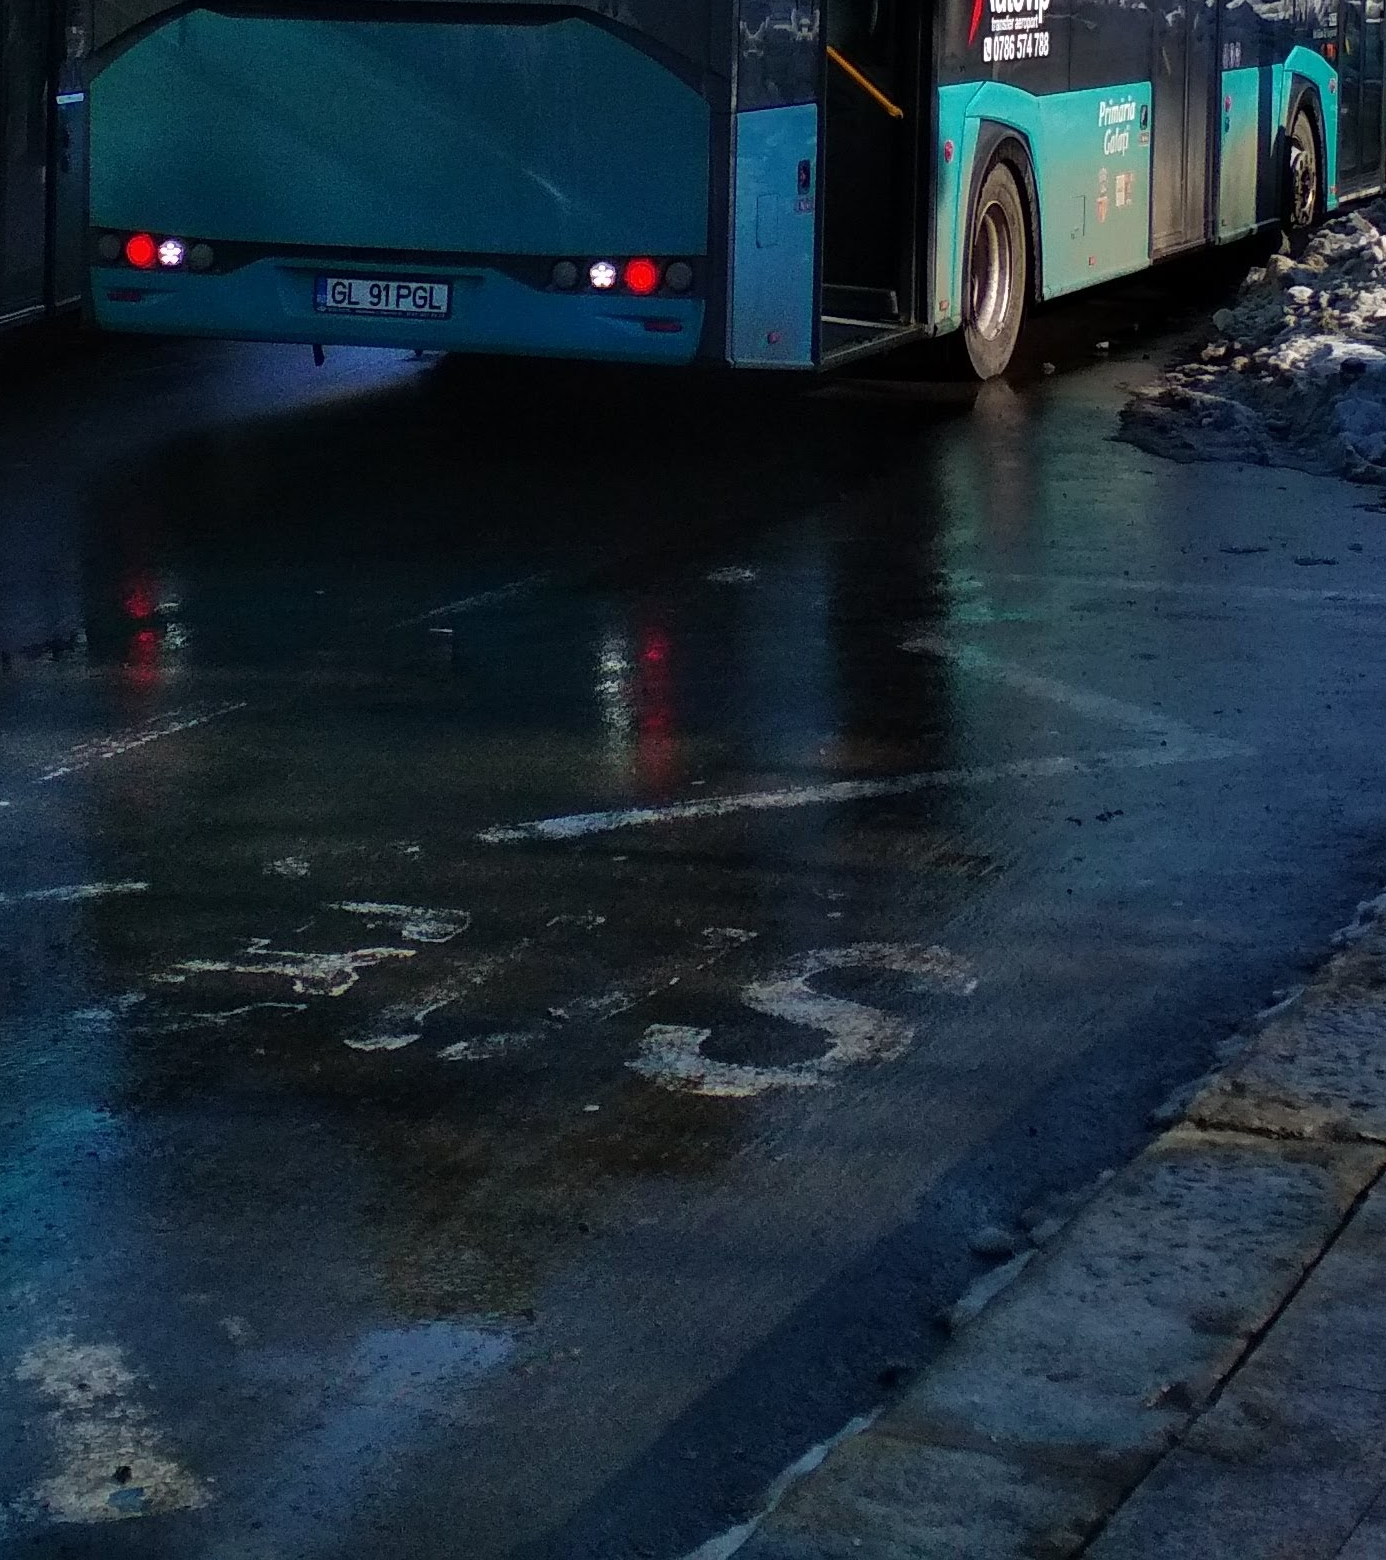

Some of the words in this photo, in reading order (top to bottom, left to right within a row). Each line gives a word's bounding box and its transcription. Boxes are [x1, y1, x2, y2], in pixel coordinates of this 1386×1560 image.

[994, 35, 1015, 61] 0786
[1016, 33, 1032, 59] 574
[1034, 32, 1050, 57] 788
[332, 281, 360, 305] GL
[369, 283, 390, 307] 91
[396, 284, 441, 310] PGL
